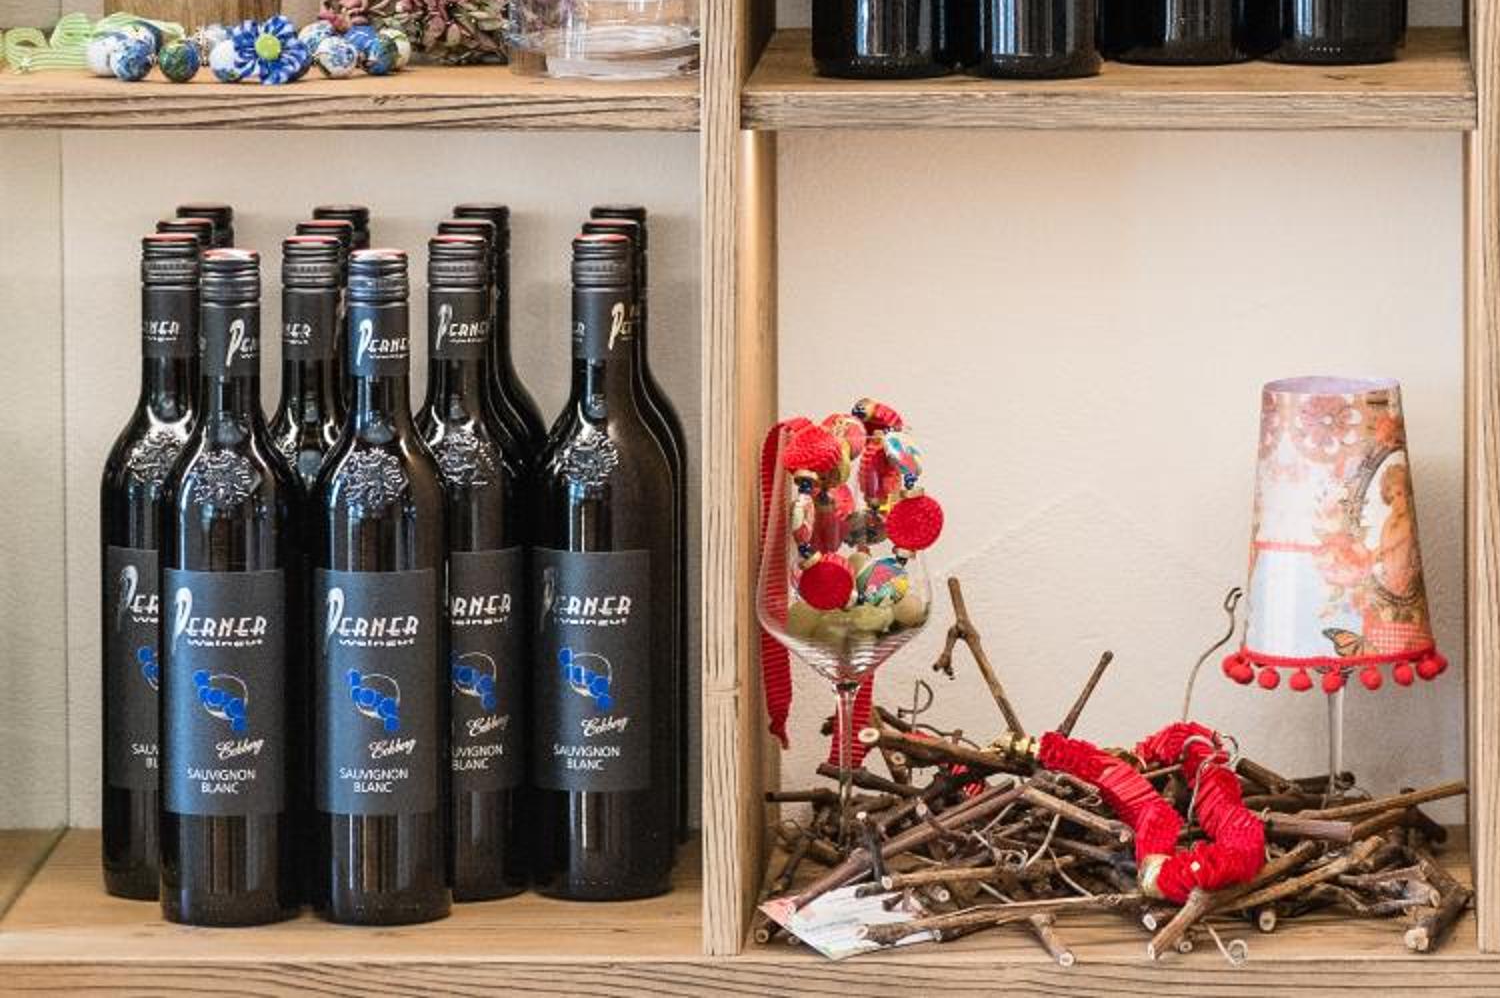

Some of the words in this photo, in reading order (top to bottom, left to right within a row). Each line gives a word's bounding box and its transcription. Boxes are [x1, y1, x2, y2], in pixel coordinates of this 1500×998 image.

[171, 587, 267, 656] PERNER
[324, 587, 419, 656] PERNER
[451, 744, 503, 759] UVIGNON
[553, 743, 620, 757] SAUVIGNON
[567, 757, 604, 771] BLANC
[186, 768, 256, 781] SAUVIGNON
[339, 768, 408, 780] SAUVIGNON
[201, 782, 239, 794] BLANC
[353, 781, 393, 793] BLANC
